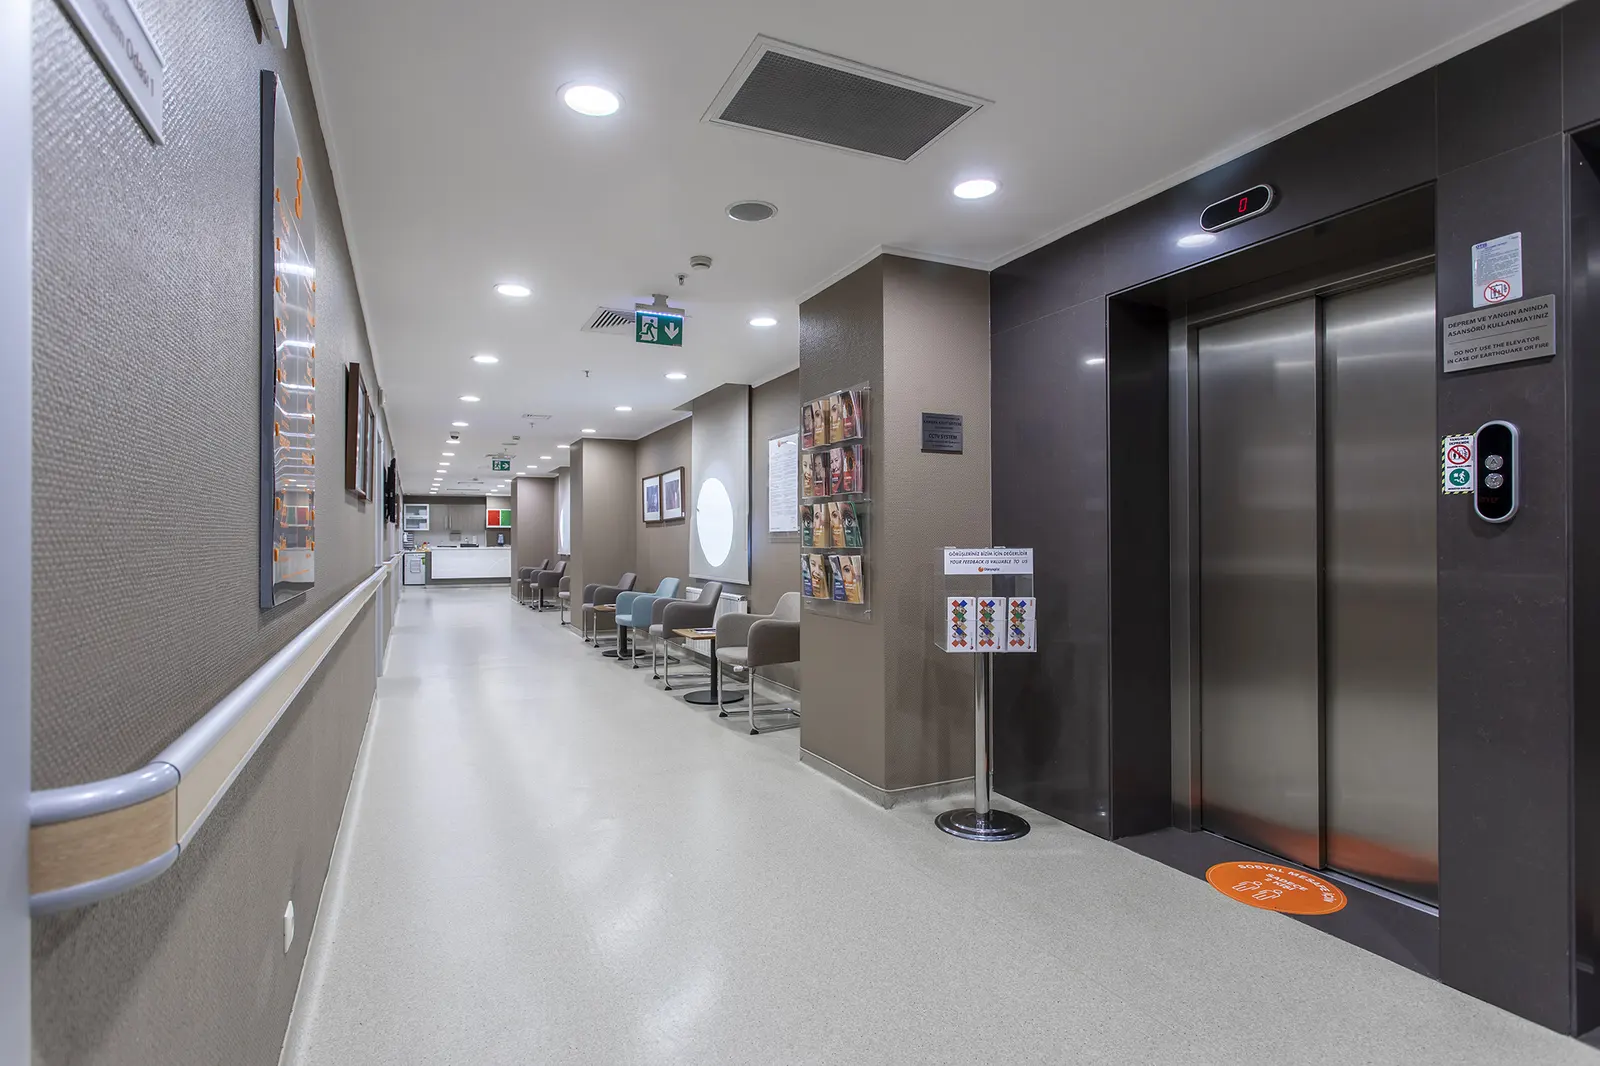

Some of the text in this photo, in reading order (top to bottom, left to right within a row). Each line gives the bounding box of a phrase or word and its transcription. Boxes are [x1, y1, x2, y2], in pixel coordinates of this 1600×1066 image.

[1238, 197, 1248, 212] 0
[1448, 318, 1476, 329] DEPREM
[1488, 310, 1516, 320] YANGIN
[1518, 303, 1549, 314] ANINDA
[1448, 312, 1549, 337] ASANSÖRÜ KULLANMAYINIZ
[1506, 336, 1540, 347] ELEVATOR
[1480, 347, 1523, 358] EARTHQUAKE
[1238, 864, 1284, 874] SOSYAL
[1266, 873, 1308, 891] SADECE
